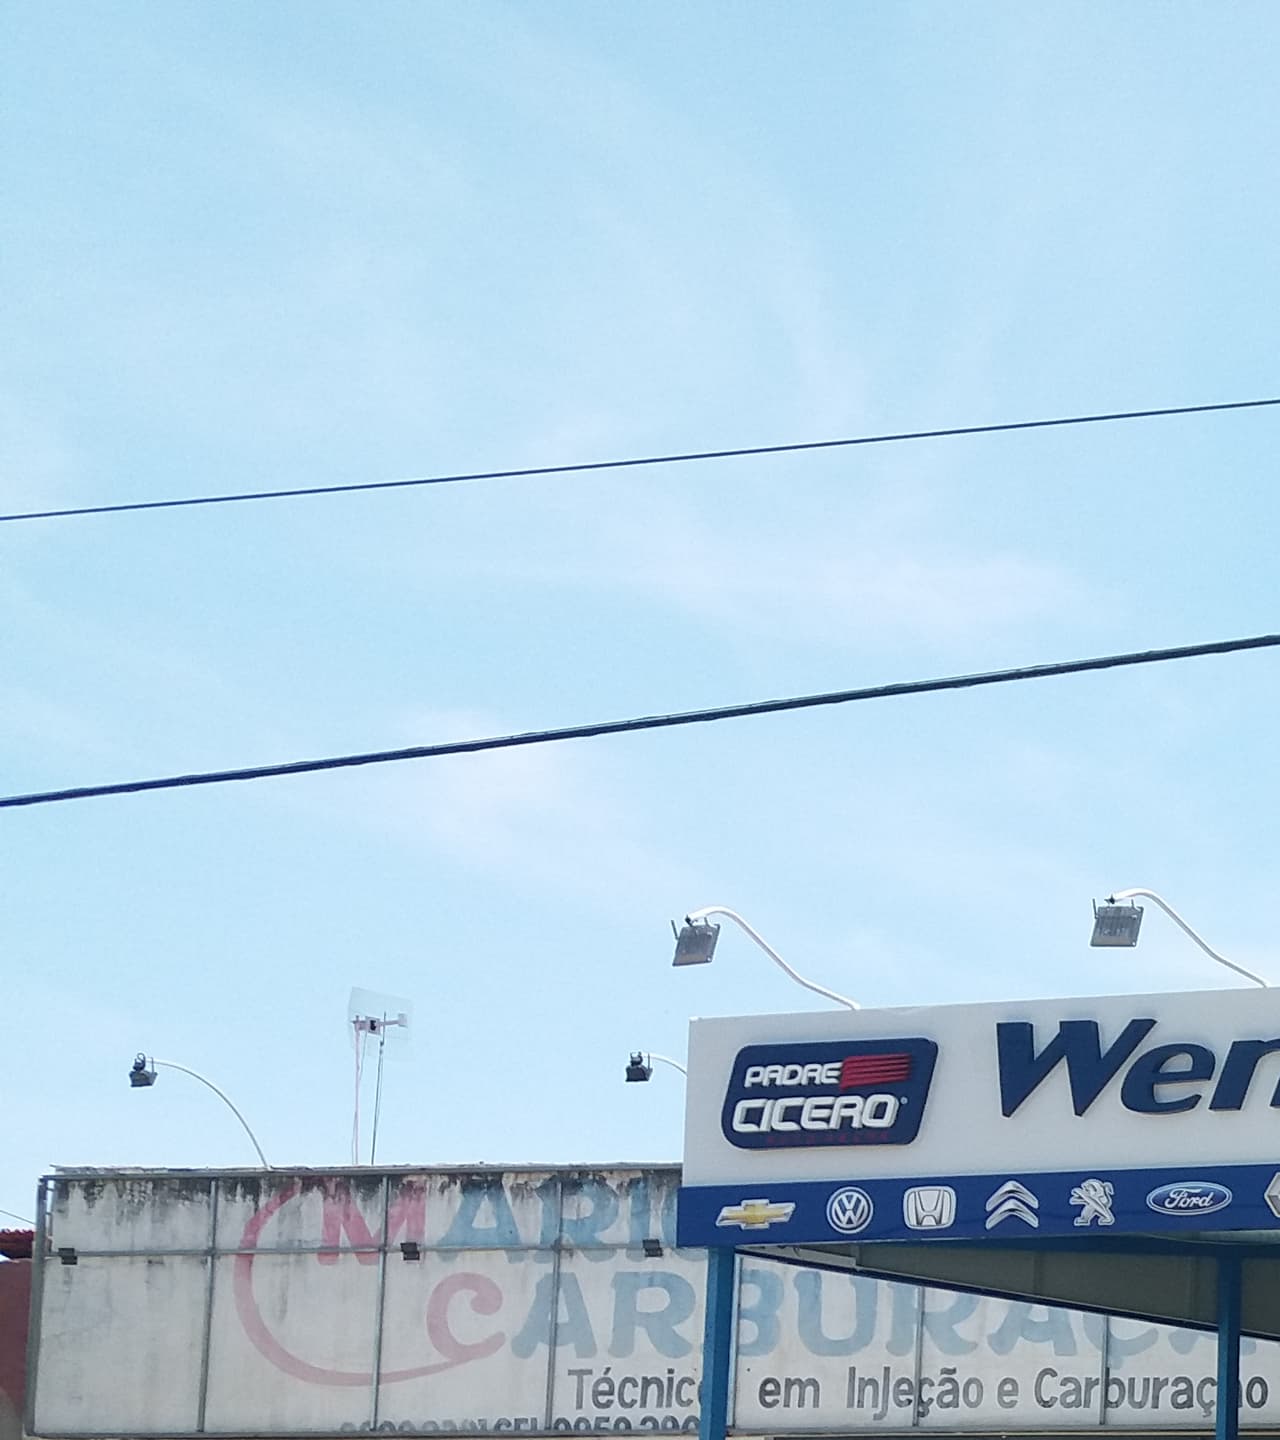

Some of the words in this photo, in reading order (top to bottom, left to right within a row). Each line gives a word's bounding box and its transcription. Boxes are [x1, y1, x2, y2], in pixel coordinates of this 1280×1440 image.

[744, 1061, 843, 1088] PADRE
[732, 1093, 899, 1133] CICERO
[1163, 1188, 1214, 1209] Ford
[568, 1367, 702, 1410] Técnic
[758, 1377, 820, 1409] em
[997, 1376, 1019, 1409] e
[1034, 1367, 1269, 1418] Carburaço
